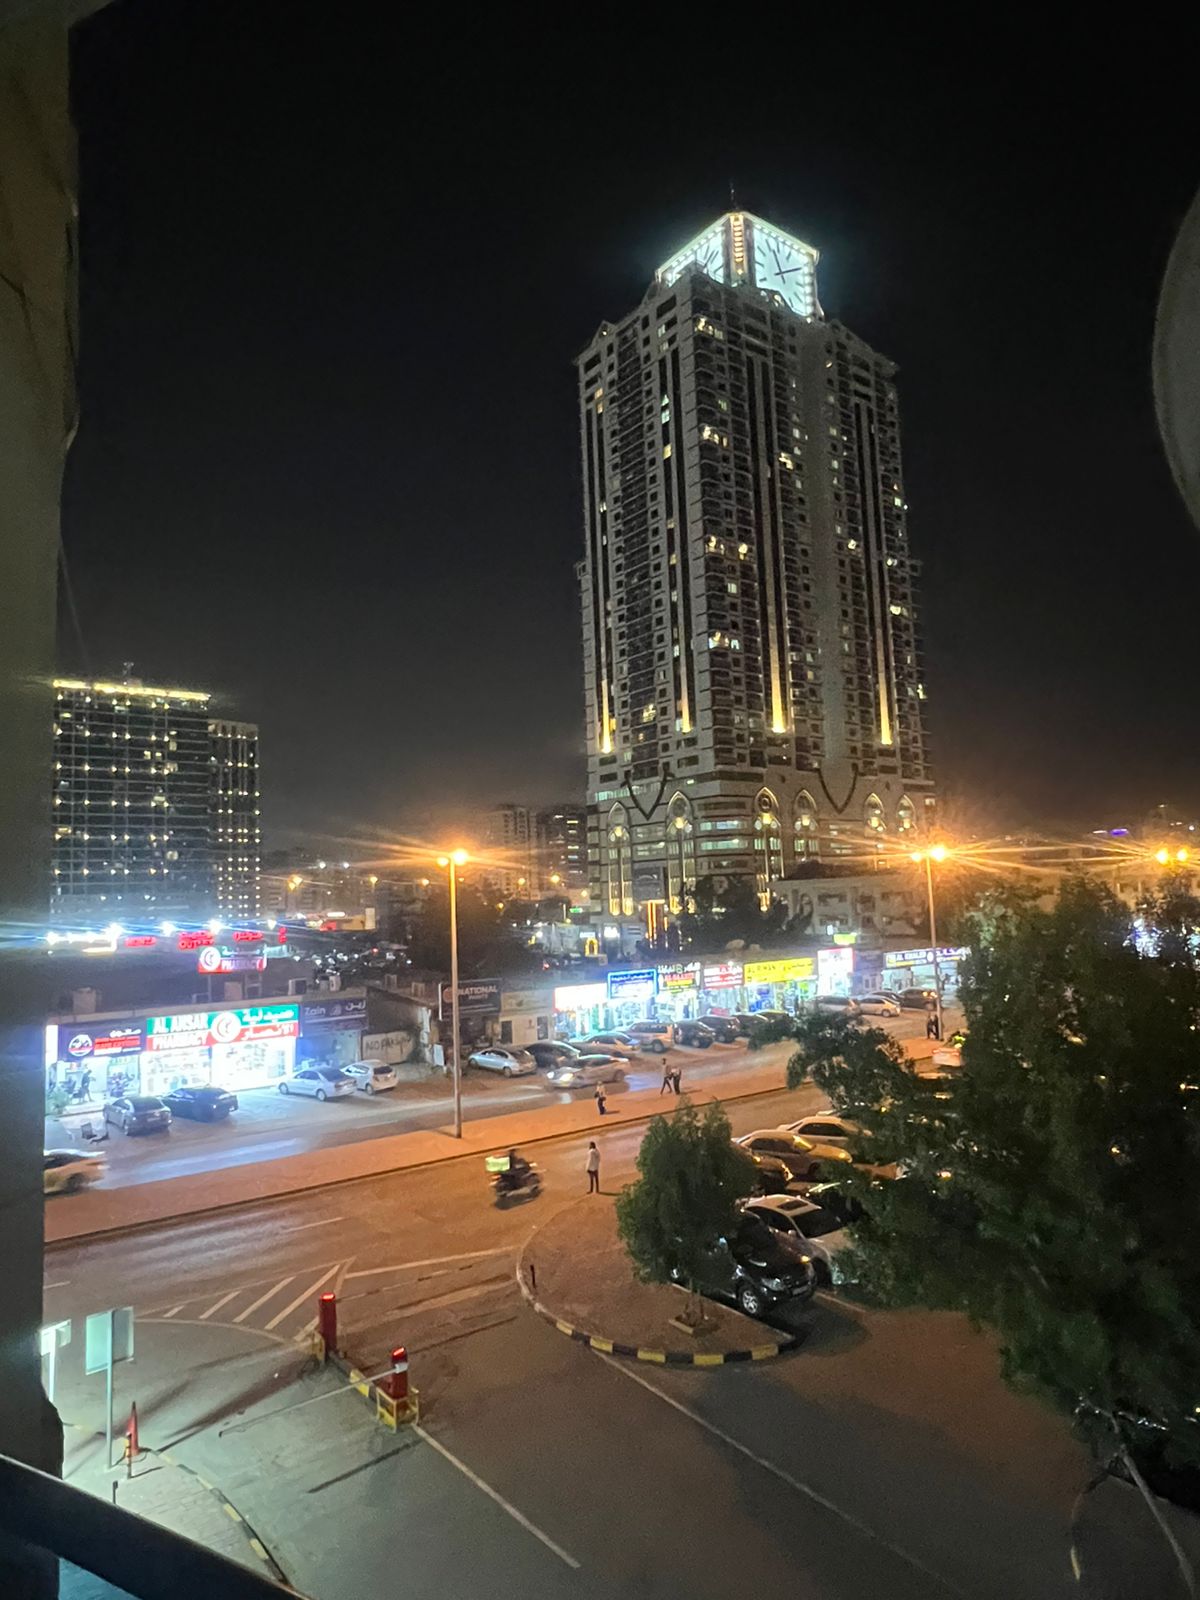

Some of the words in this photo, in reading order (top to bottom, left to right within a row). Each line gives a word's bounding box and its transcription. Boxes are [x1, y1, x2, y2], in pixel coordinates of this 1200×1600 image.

[457, 985, 497, 995] NATIONAL
[305, 1006, 326, 1016] Zain
[153, 1016, 169, 1034] AL
[171, 1013, 209, 1032] ANSAR
[152, 1032, 208, 1050] PHARMACY
